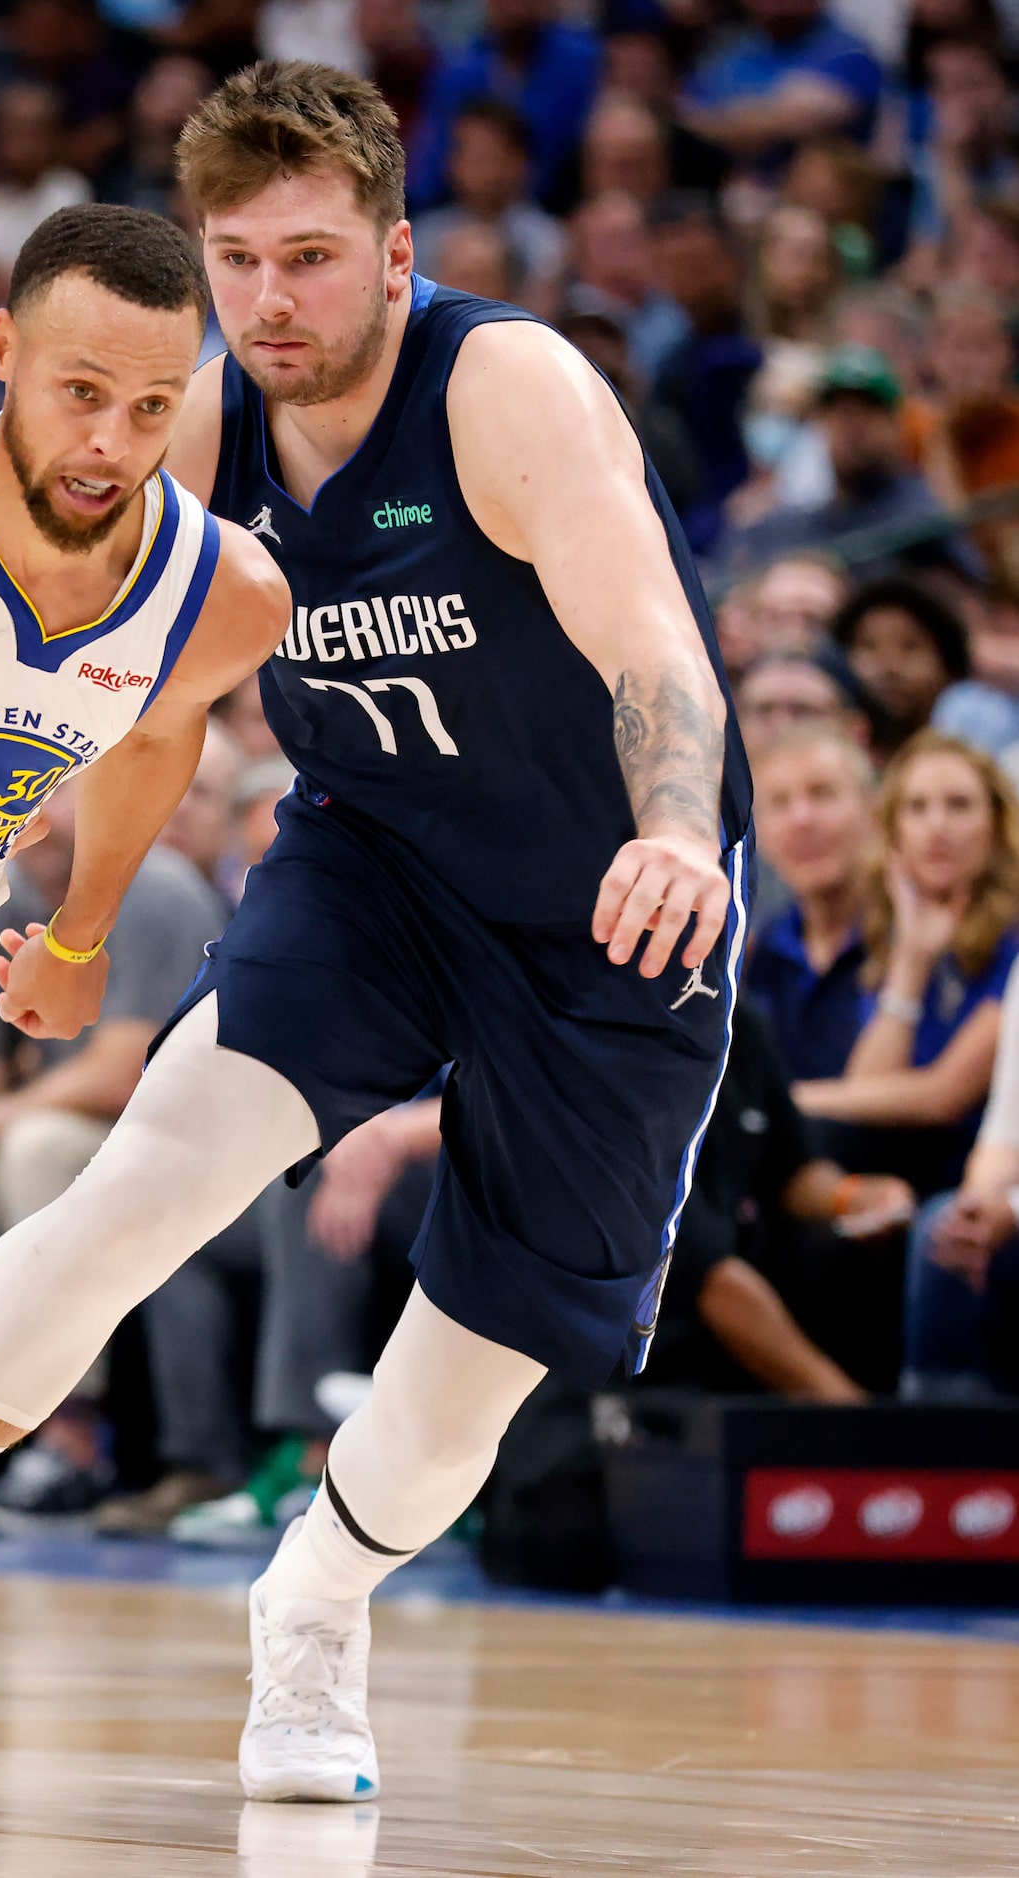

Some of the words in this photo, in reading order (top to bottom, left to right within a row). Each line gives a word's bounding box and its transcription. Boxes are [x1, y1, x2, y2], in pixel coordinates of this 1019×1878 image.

[373, 501, 433, 529] chime
[274, 593, 478, 662] VERICKS
[77, 662, 153, 691] Rakuten
[299, 676, 460, 757] 77
[52, 723, 98, 764] STA
